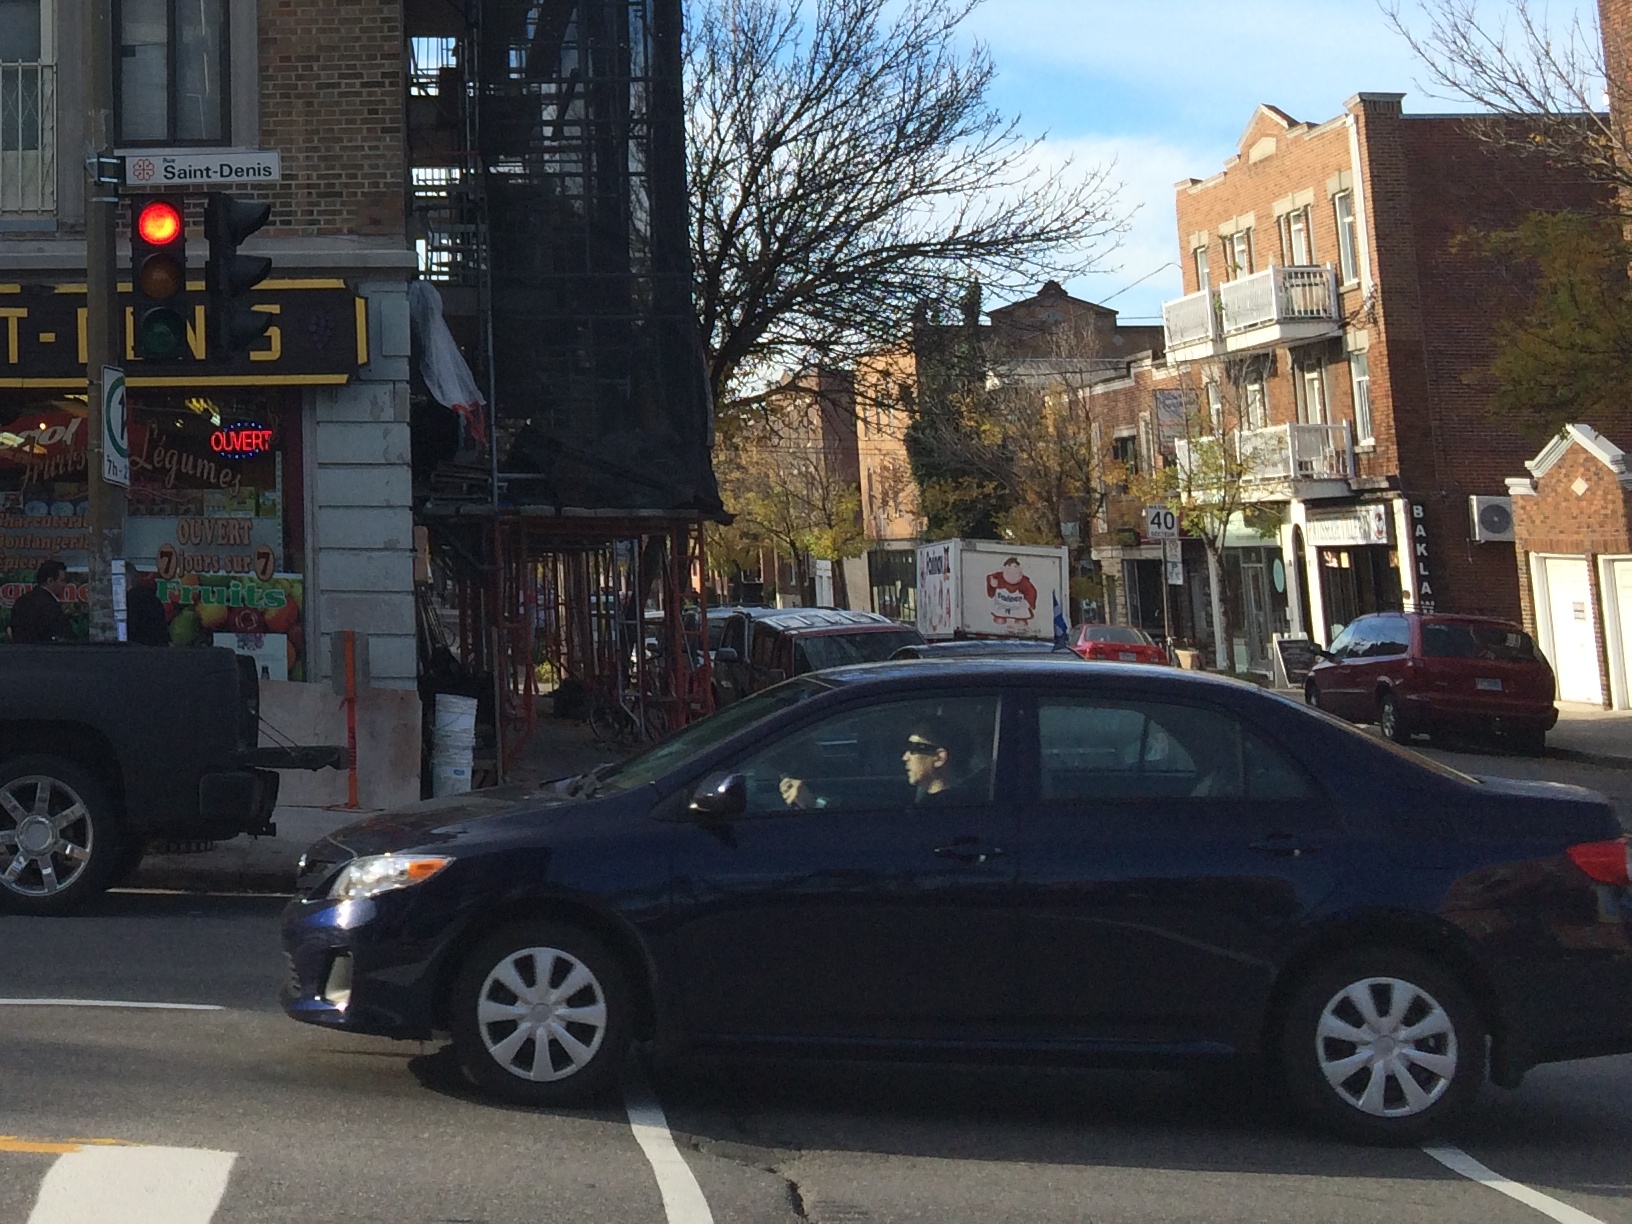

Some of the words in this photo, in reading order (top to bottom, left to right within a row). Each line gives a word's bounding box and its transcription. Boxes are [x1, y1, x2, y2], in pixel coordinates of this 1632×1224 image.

[163, 162, 273, 180] Saint-Denis
[210, 430, 273, 452] OUVERT
[129, 418, 241, 496] Légumes
[176, 518, 253, 546] OUVERT
[1150, 511, 1175, 530] 40
[159, 551, 175, 575] 7
[178, 551, 220, 574] jours
[223, 556, 252, 572] sur
[256, 552, 272, 576] 7
[156, 579, 286, 608] Fruits
